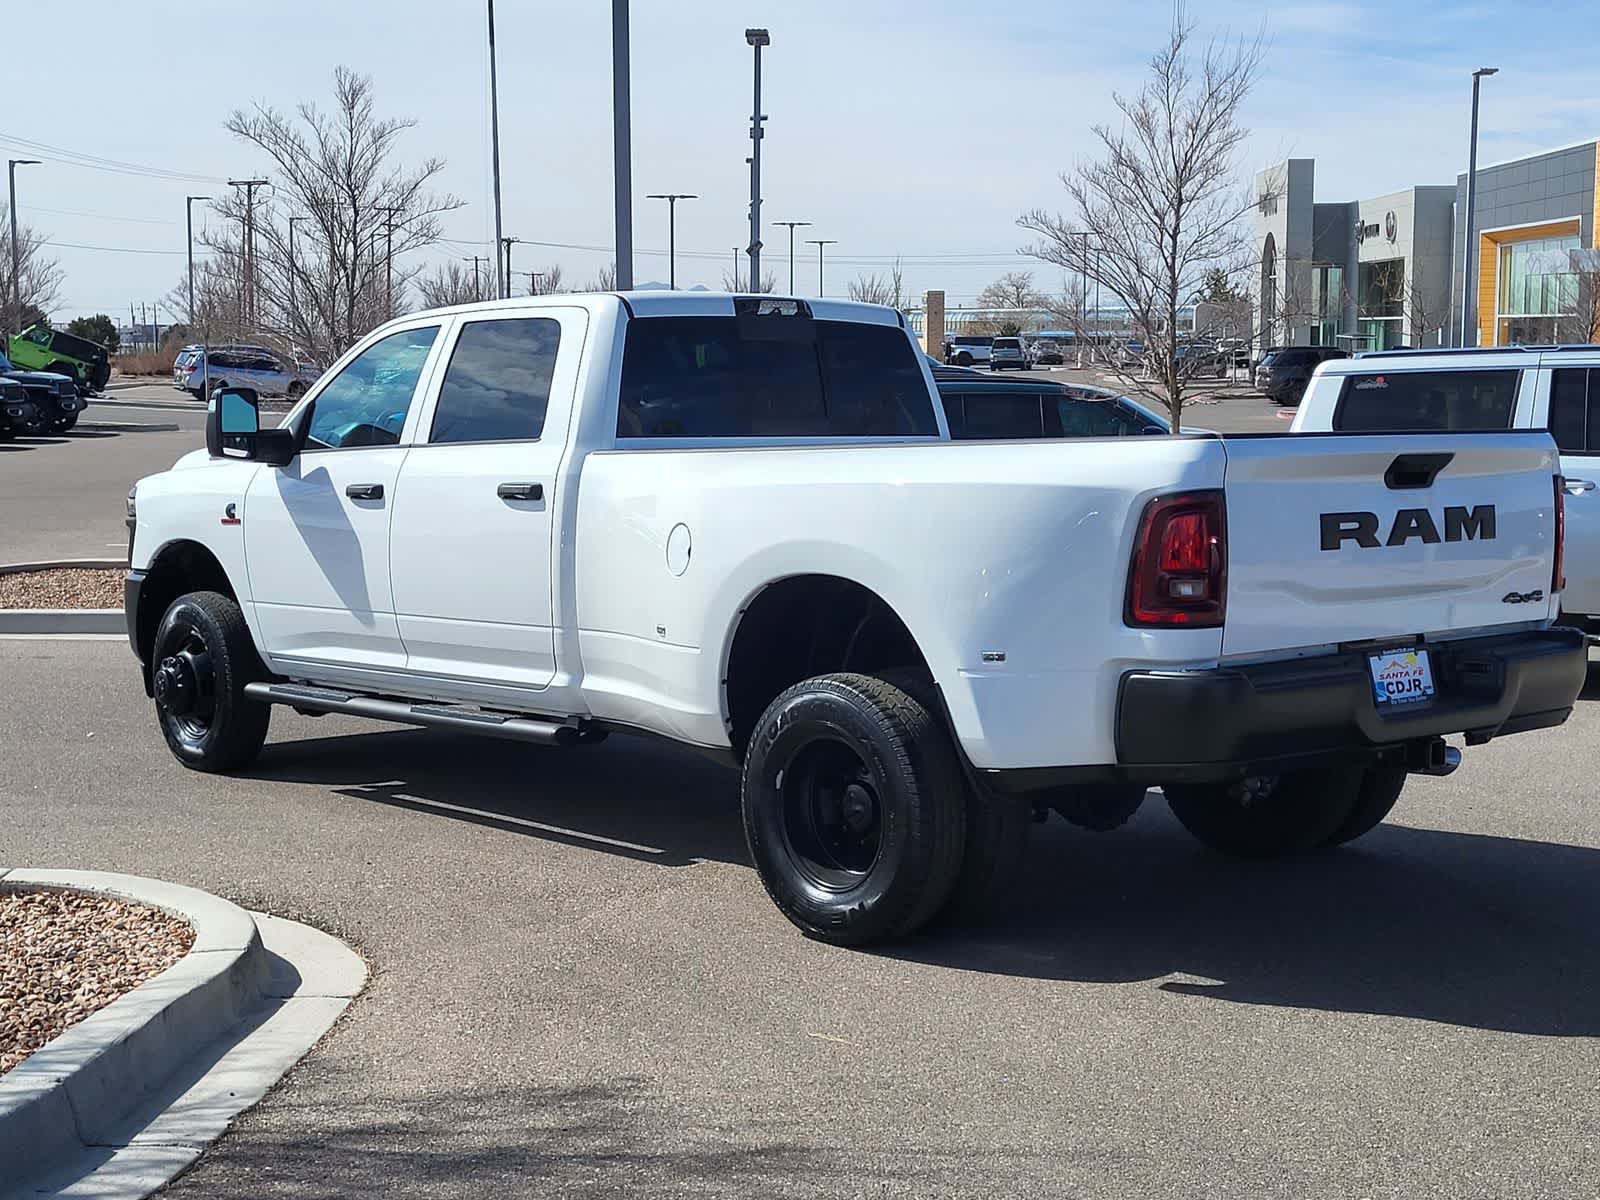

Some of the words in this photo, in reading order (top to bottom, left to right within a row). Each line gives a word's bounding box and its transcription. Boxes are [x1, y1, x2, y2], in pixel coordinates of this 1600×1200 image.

[1320, 504, 1496, 551] RAM
[1379, 671, 1410, 680] SANTA
[1386, 679, 1422, 694] CDJR
